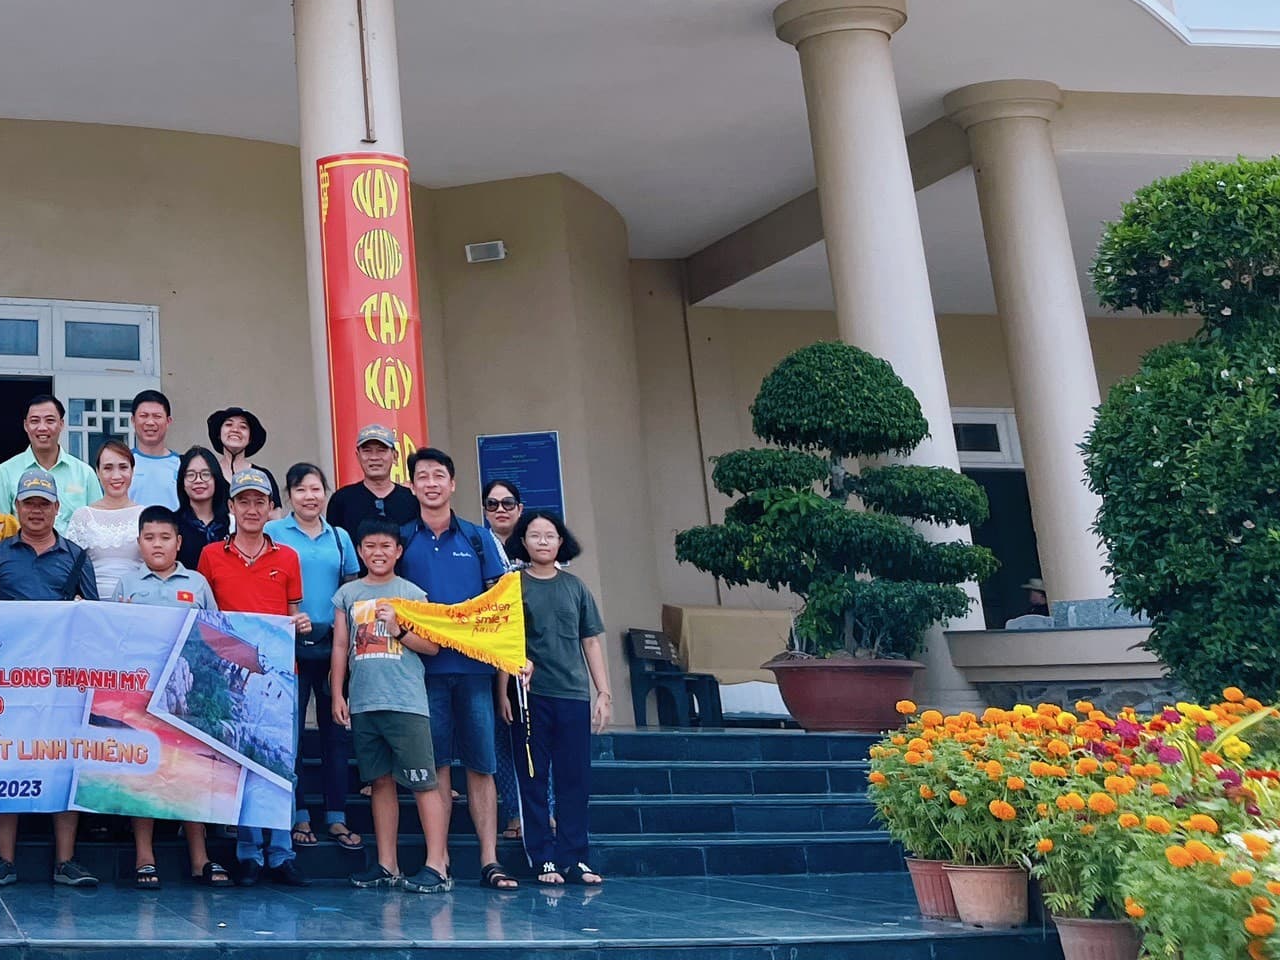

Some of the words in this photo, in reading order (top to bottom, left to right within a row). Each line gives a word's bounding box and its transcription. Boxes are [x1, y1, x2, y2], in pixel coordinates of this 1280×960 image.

[351, 168, 399, 219] NAY
[354, 228, 403, 281] CHUNG
[359, 291, 408, 345] TAY
[473, 602, 511, 615] golden
[475, 614, 500, 625] smile
[54, 668, 119, 692] THẠNH
[120, 668, 150, 690] MỸ
[17, 739, 67, 761] LINH
[71, 738, 149, 764] THIÊNG
